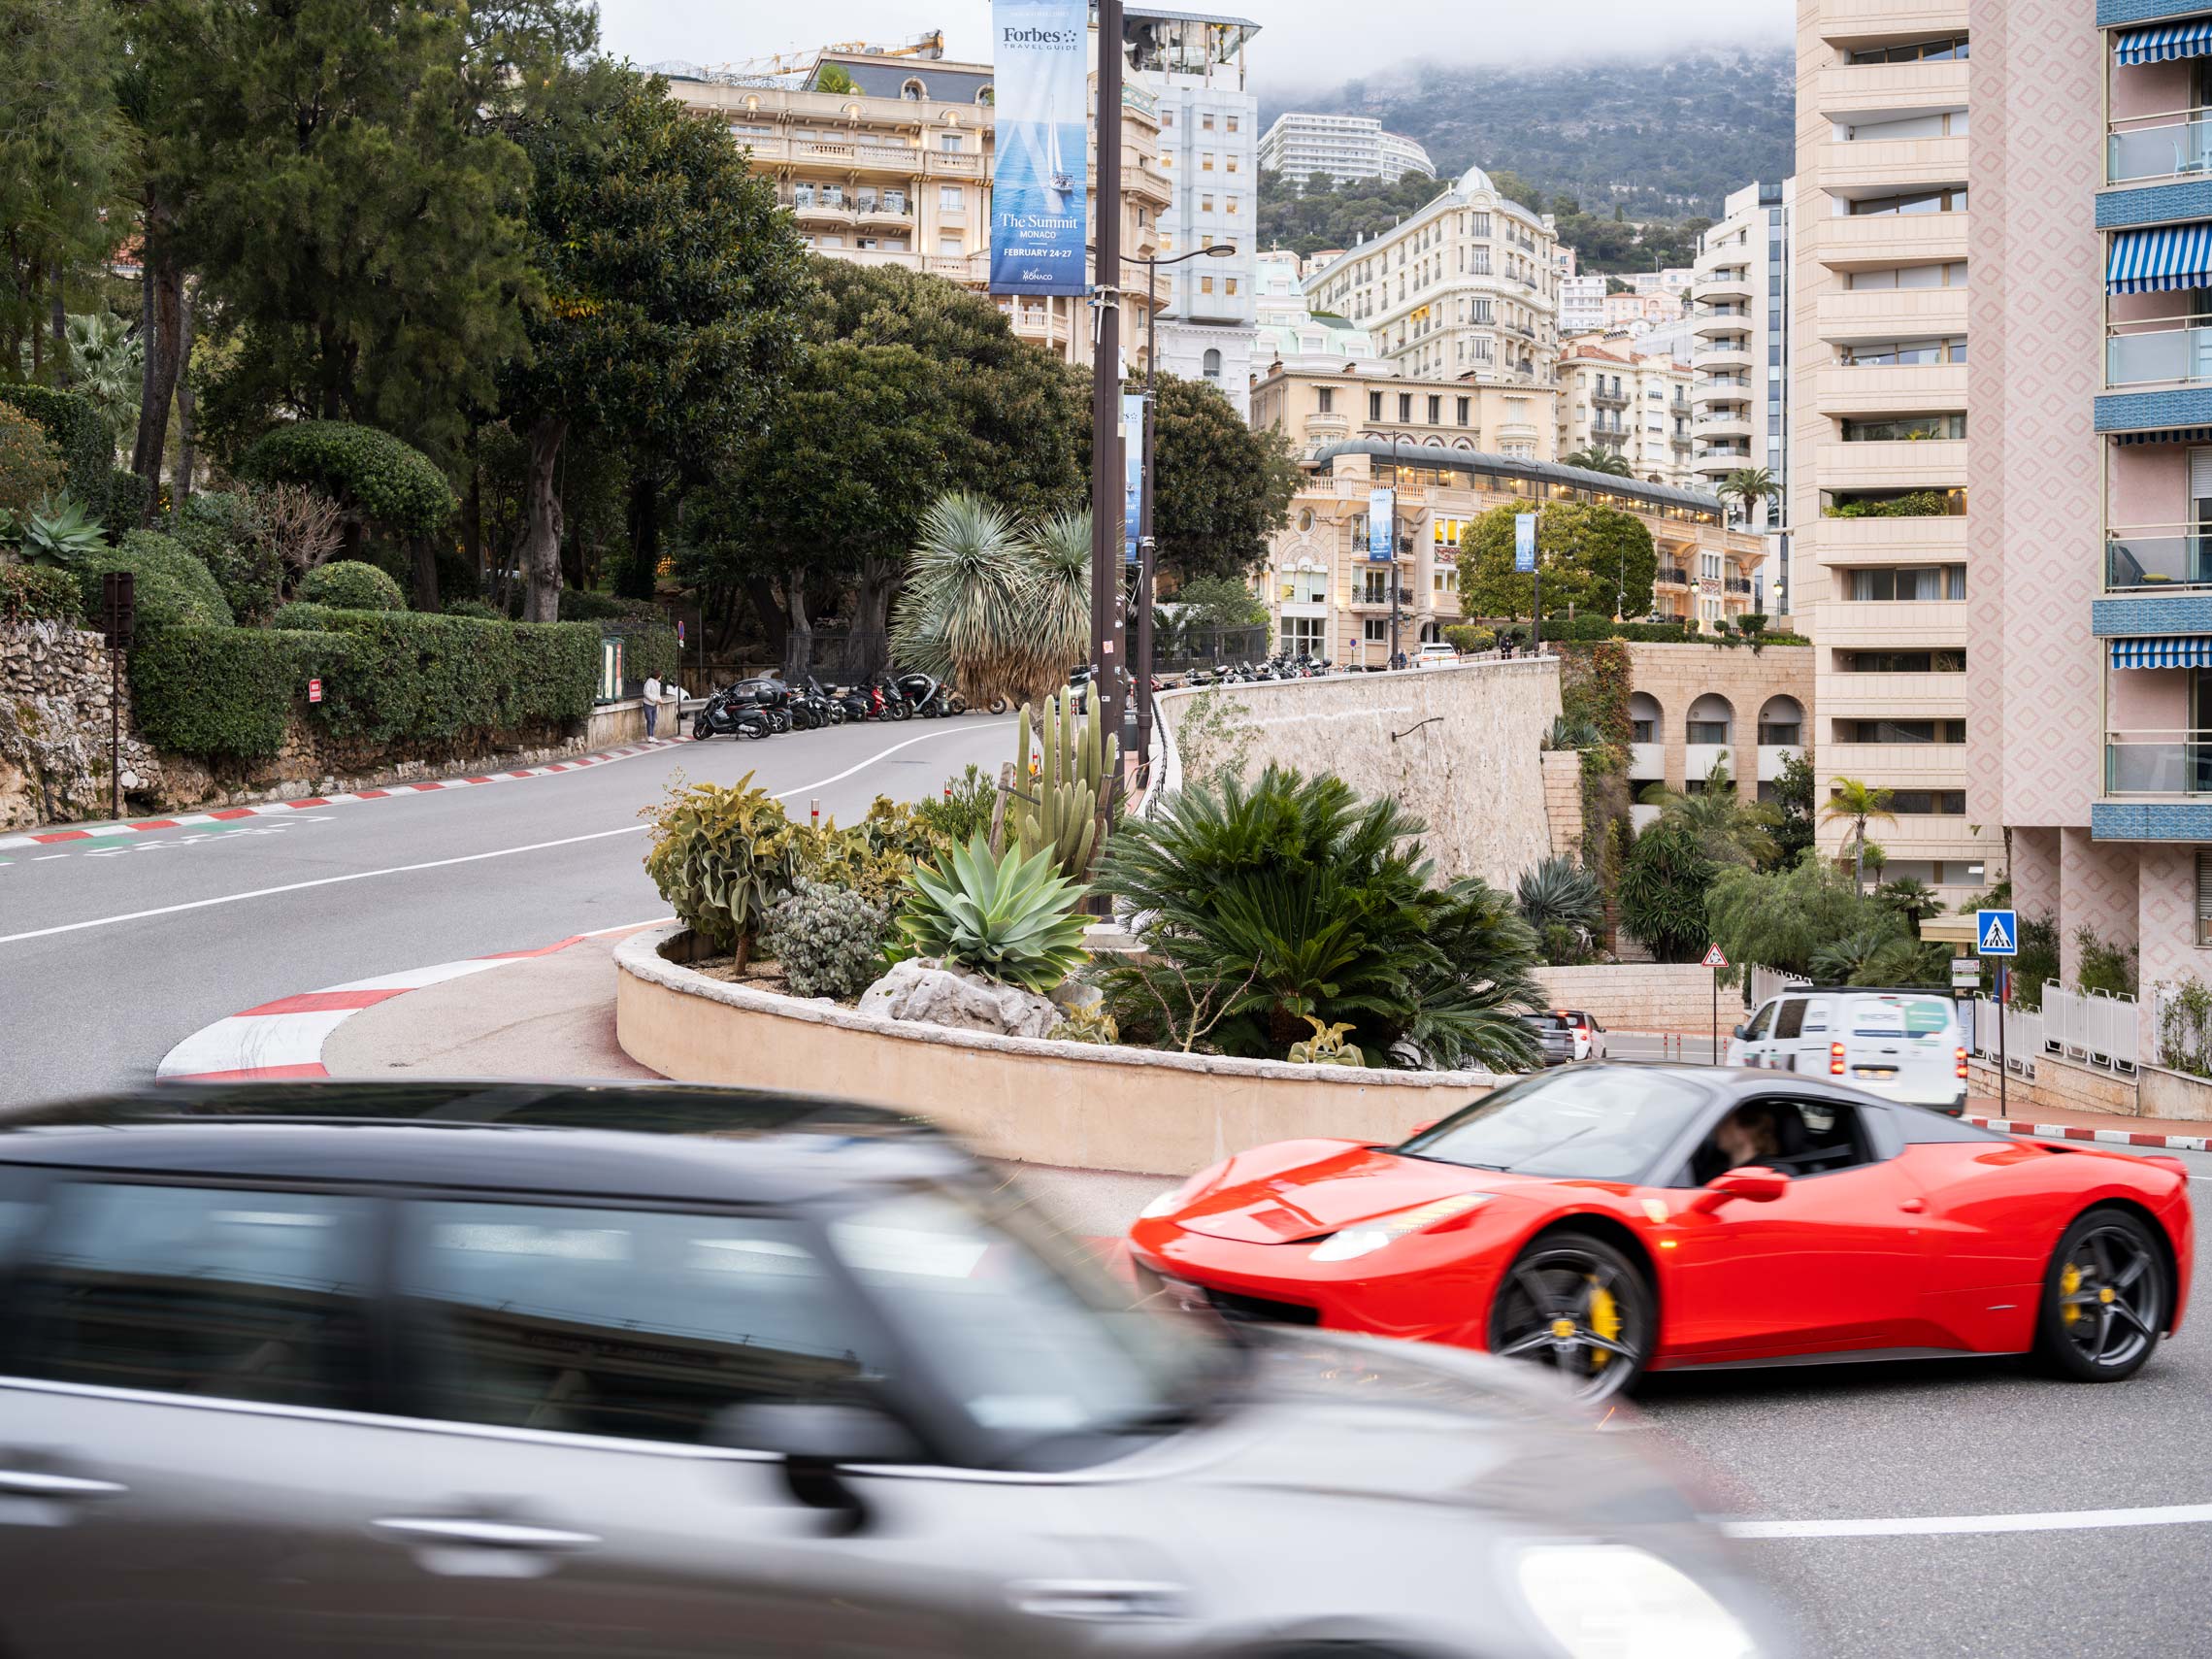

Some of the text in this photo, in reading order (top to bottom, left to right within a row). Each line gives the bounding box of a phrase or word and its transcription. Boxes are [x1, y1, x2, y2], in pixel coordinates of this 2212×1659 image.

[1003, 27, 1061, 43] Forbes
[1000, 213, 1078, 229] The Summit
[1019, 230, 1057, 239] MONACO
[1004, 248, 1073, 258] FEBRUARY 24-27
[1022, 273, 1053, 282] MONACO
